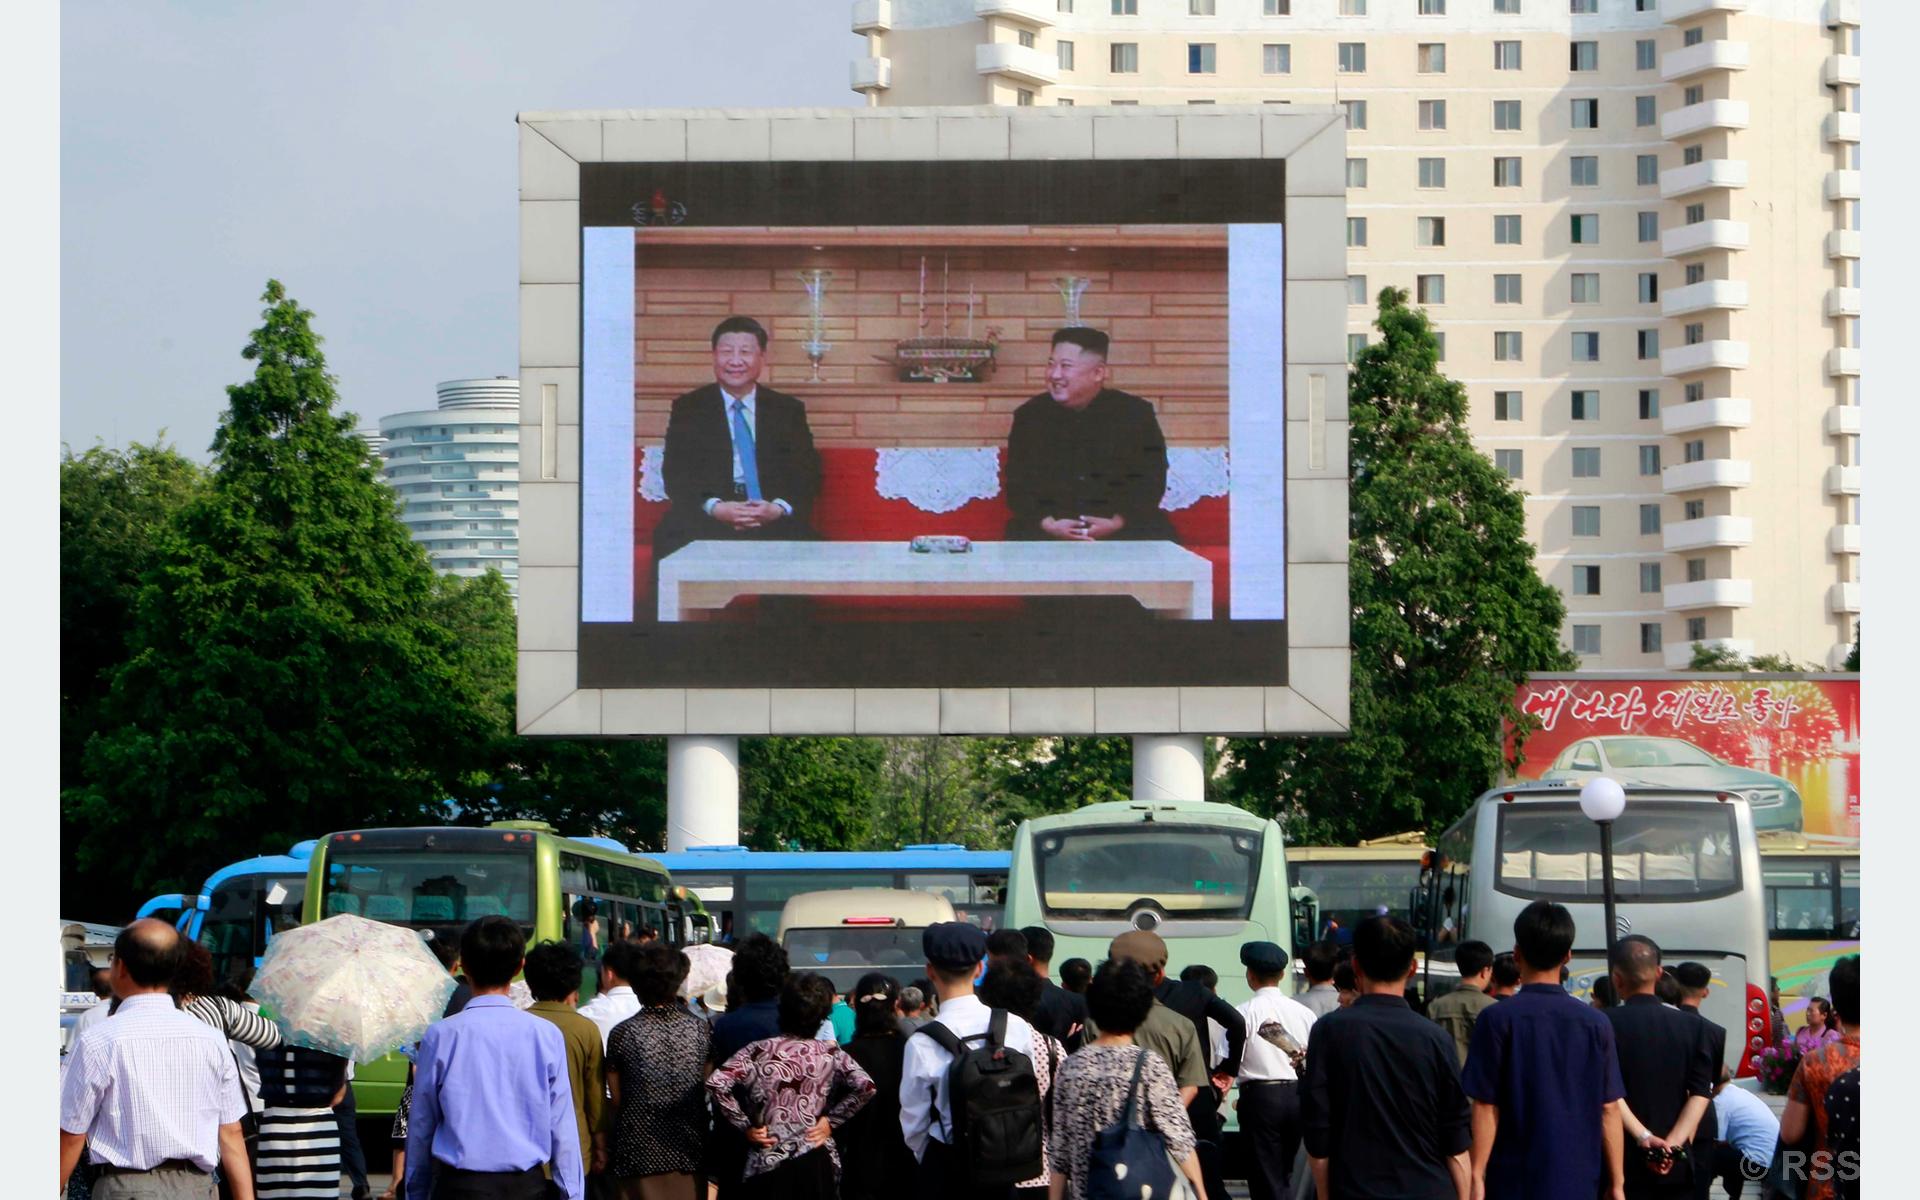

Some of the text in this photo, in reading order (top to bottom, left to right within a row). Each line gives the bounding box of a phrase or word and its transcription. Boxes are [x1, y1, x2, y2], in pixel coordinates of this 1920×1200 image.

[1522, 686, 1801, 731] 내 나라 제일로 좋아
[61, 994, 97, 1004] TAXI
